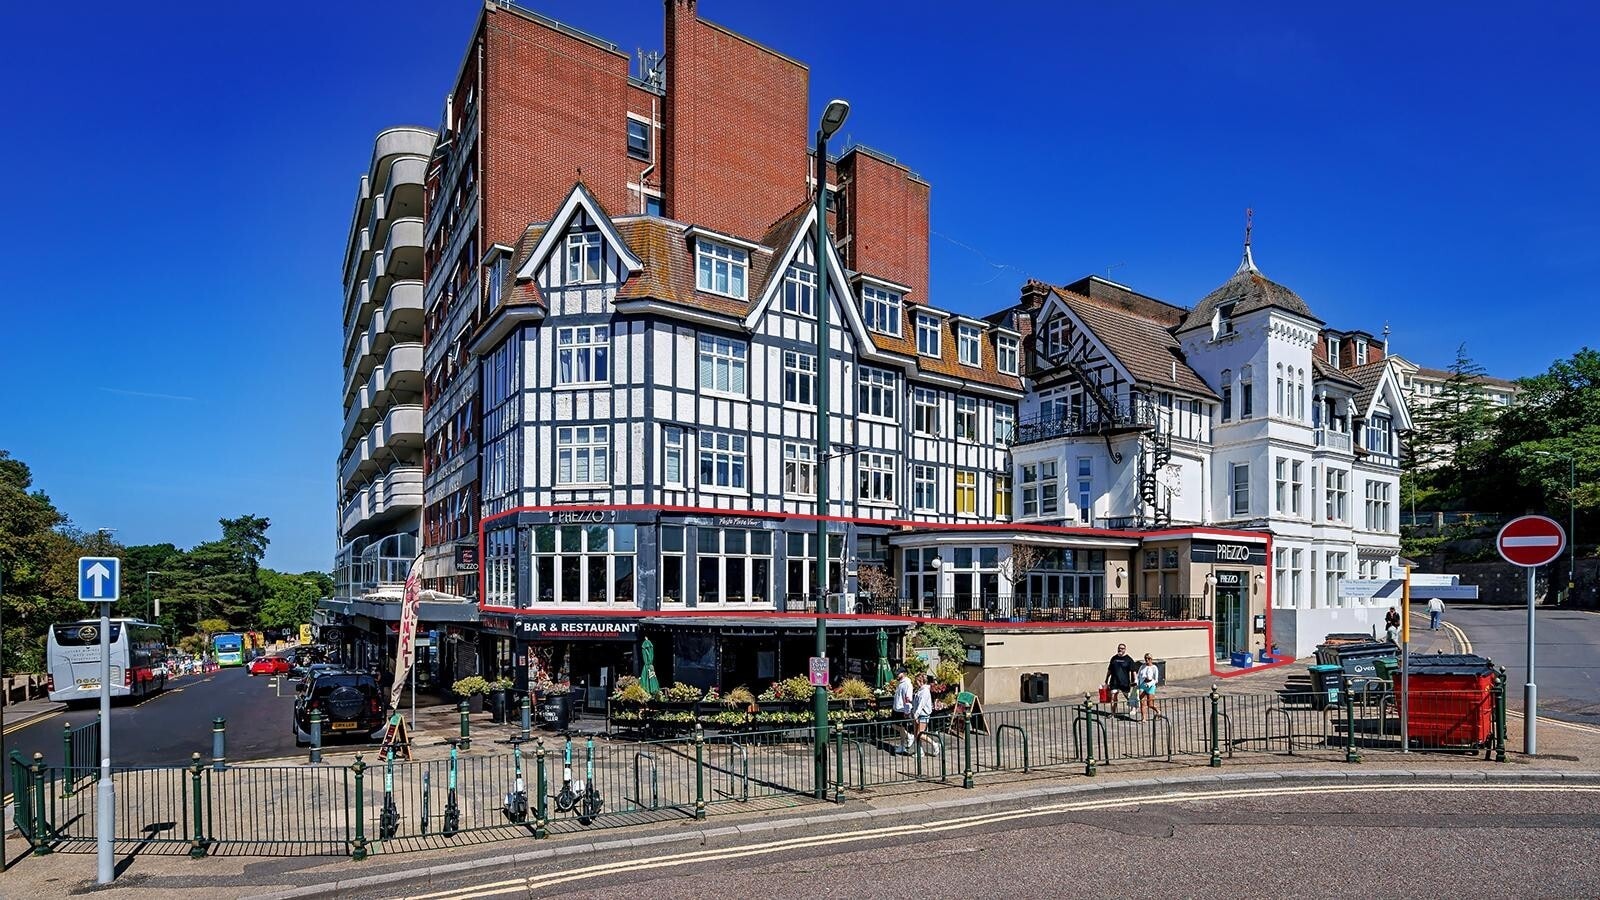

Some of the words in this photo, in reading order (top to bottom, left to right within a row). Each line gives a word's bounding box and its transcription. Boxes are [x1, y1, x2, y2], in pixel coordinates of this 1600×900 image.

[559, 510, 604, 523] PREZZO
[1217, 544, 1250, 561] PREZZO
[1220, 574, 1238, 584] PREZZO
[523, 622, 546, 632] BAR
[549, 622, 558, 632] &
[561, 623, 638, 633] RESTAURANT
